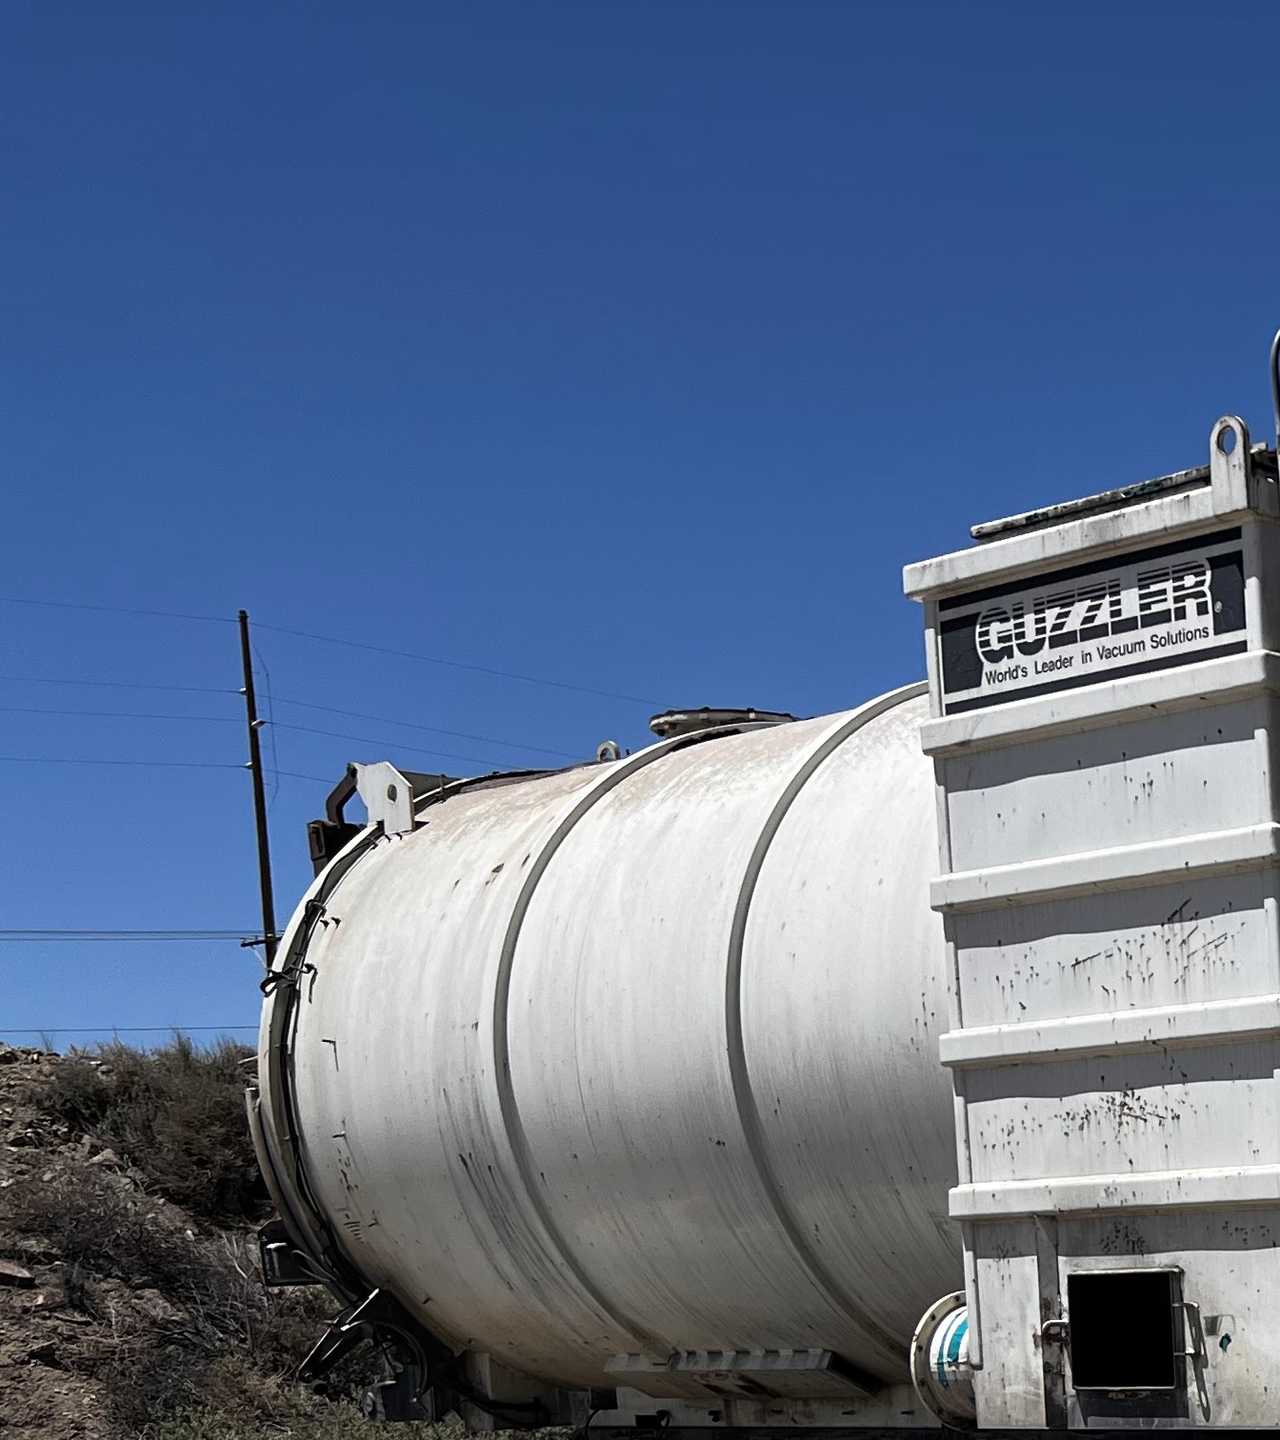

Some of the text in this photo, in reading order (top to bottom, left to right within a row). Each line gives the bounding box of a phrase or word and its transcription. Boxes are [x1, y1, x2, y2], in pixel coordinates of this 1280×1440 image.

[976, 560, 1211, 664] GUZZLER
[985, 625, 1209, 685] World's Leader in Vacuum Solutions
